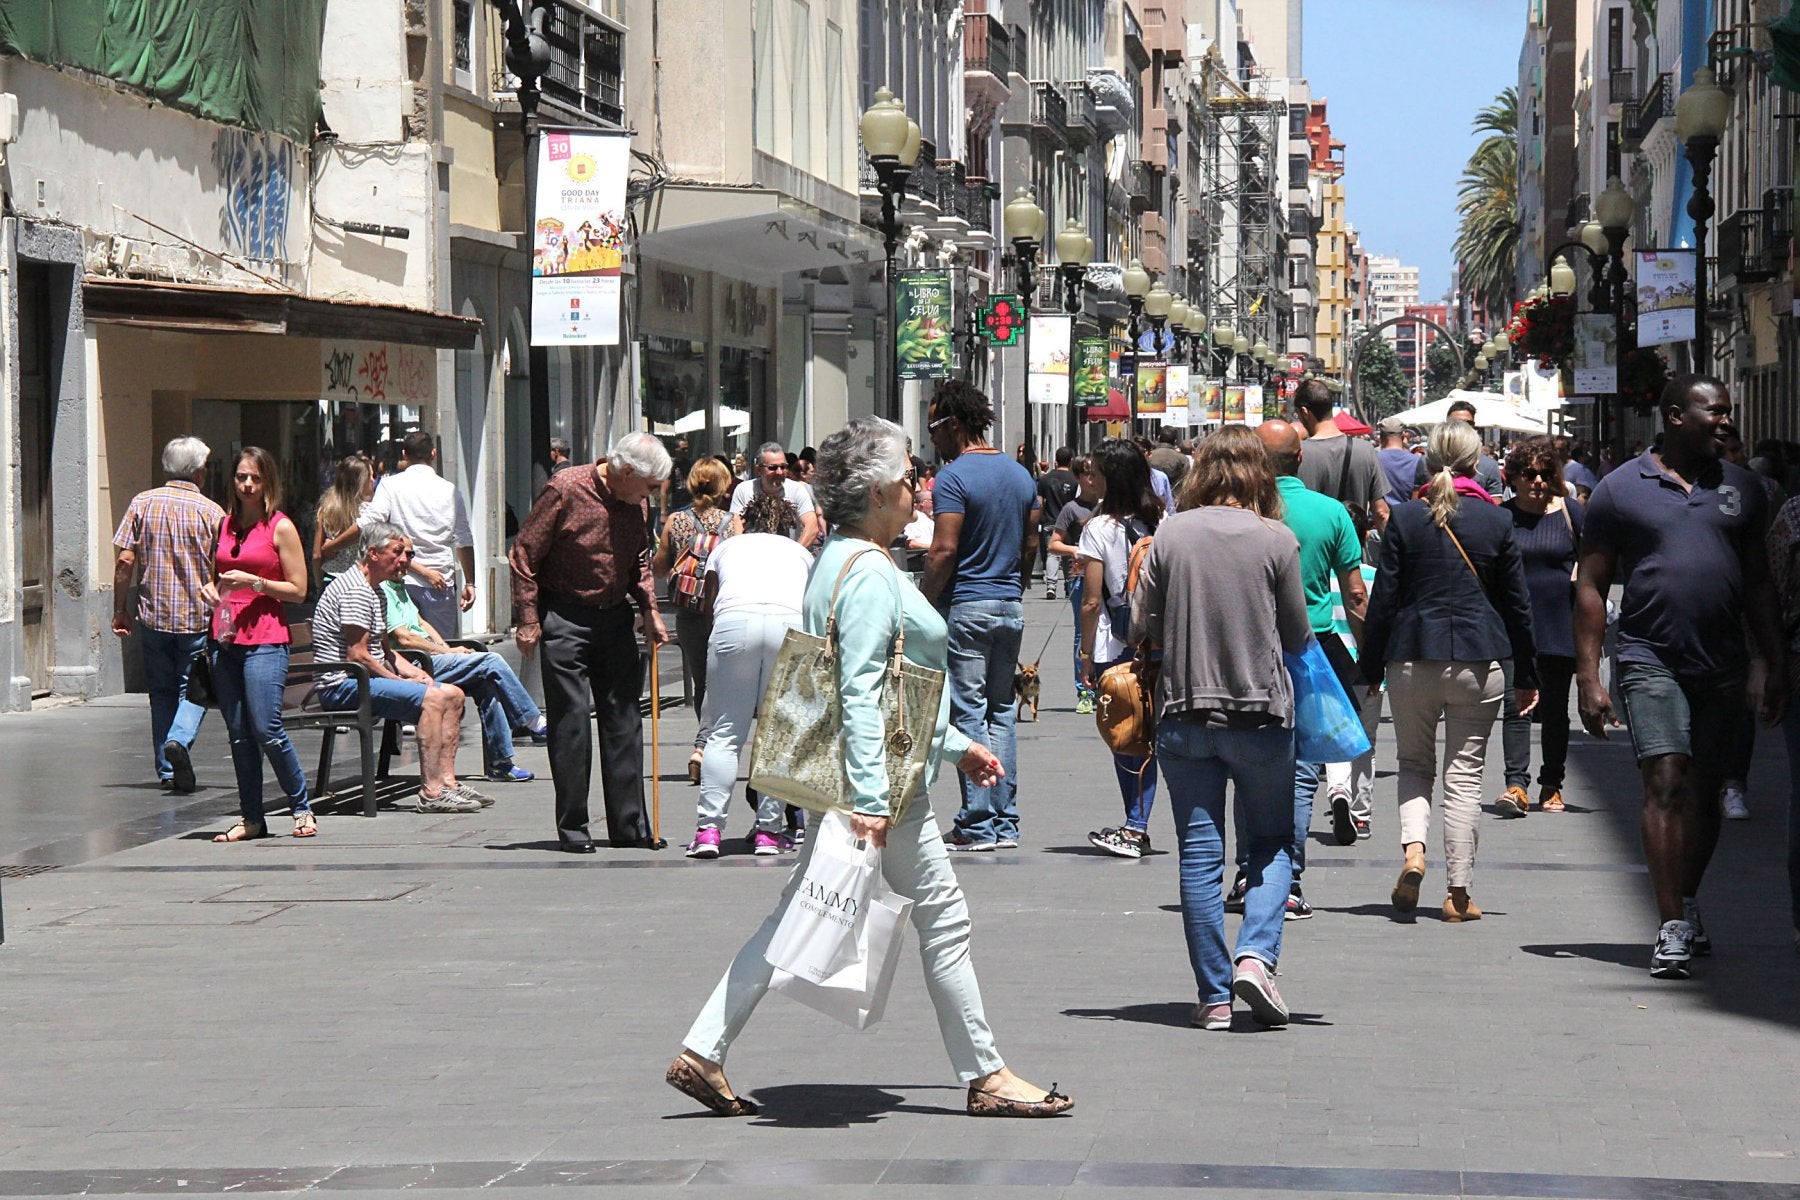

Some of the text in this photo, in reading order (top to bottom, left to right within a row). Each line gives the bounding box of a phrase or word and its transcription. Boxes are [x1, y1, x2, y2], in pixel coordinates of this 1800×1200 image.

[551, 142, 568, 155] 30
[561, 189, 599, 197] GOOD DAY
[914, 287, 940, 298] LIBRO
[1718, 485, 1741, 516] 3
